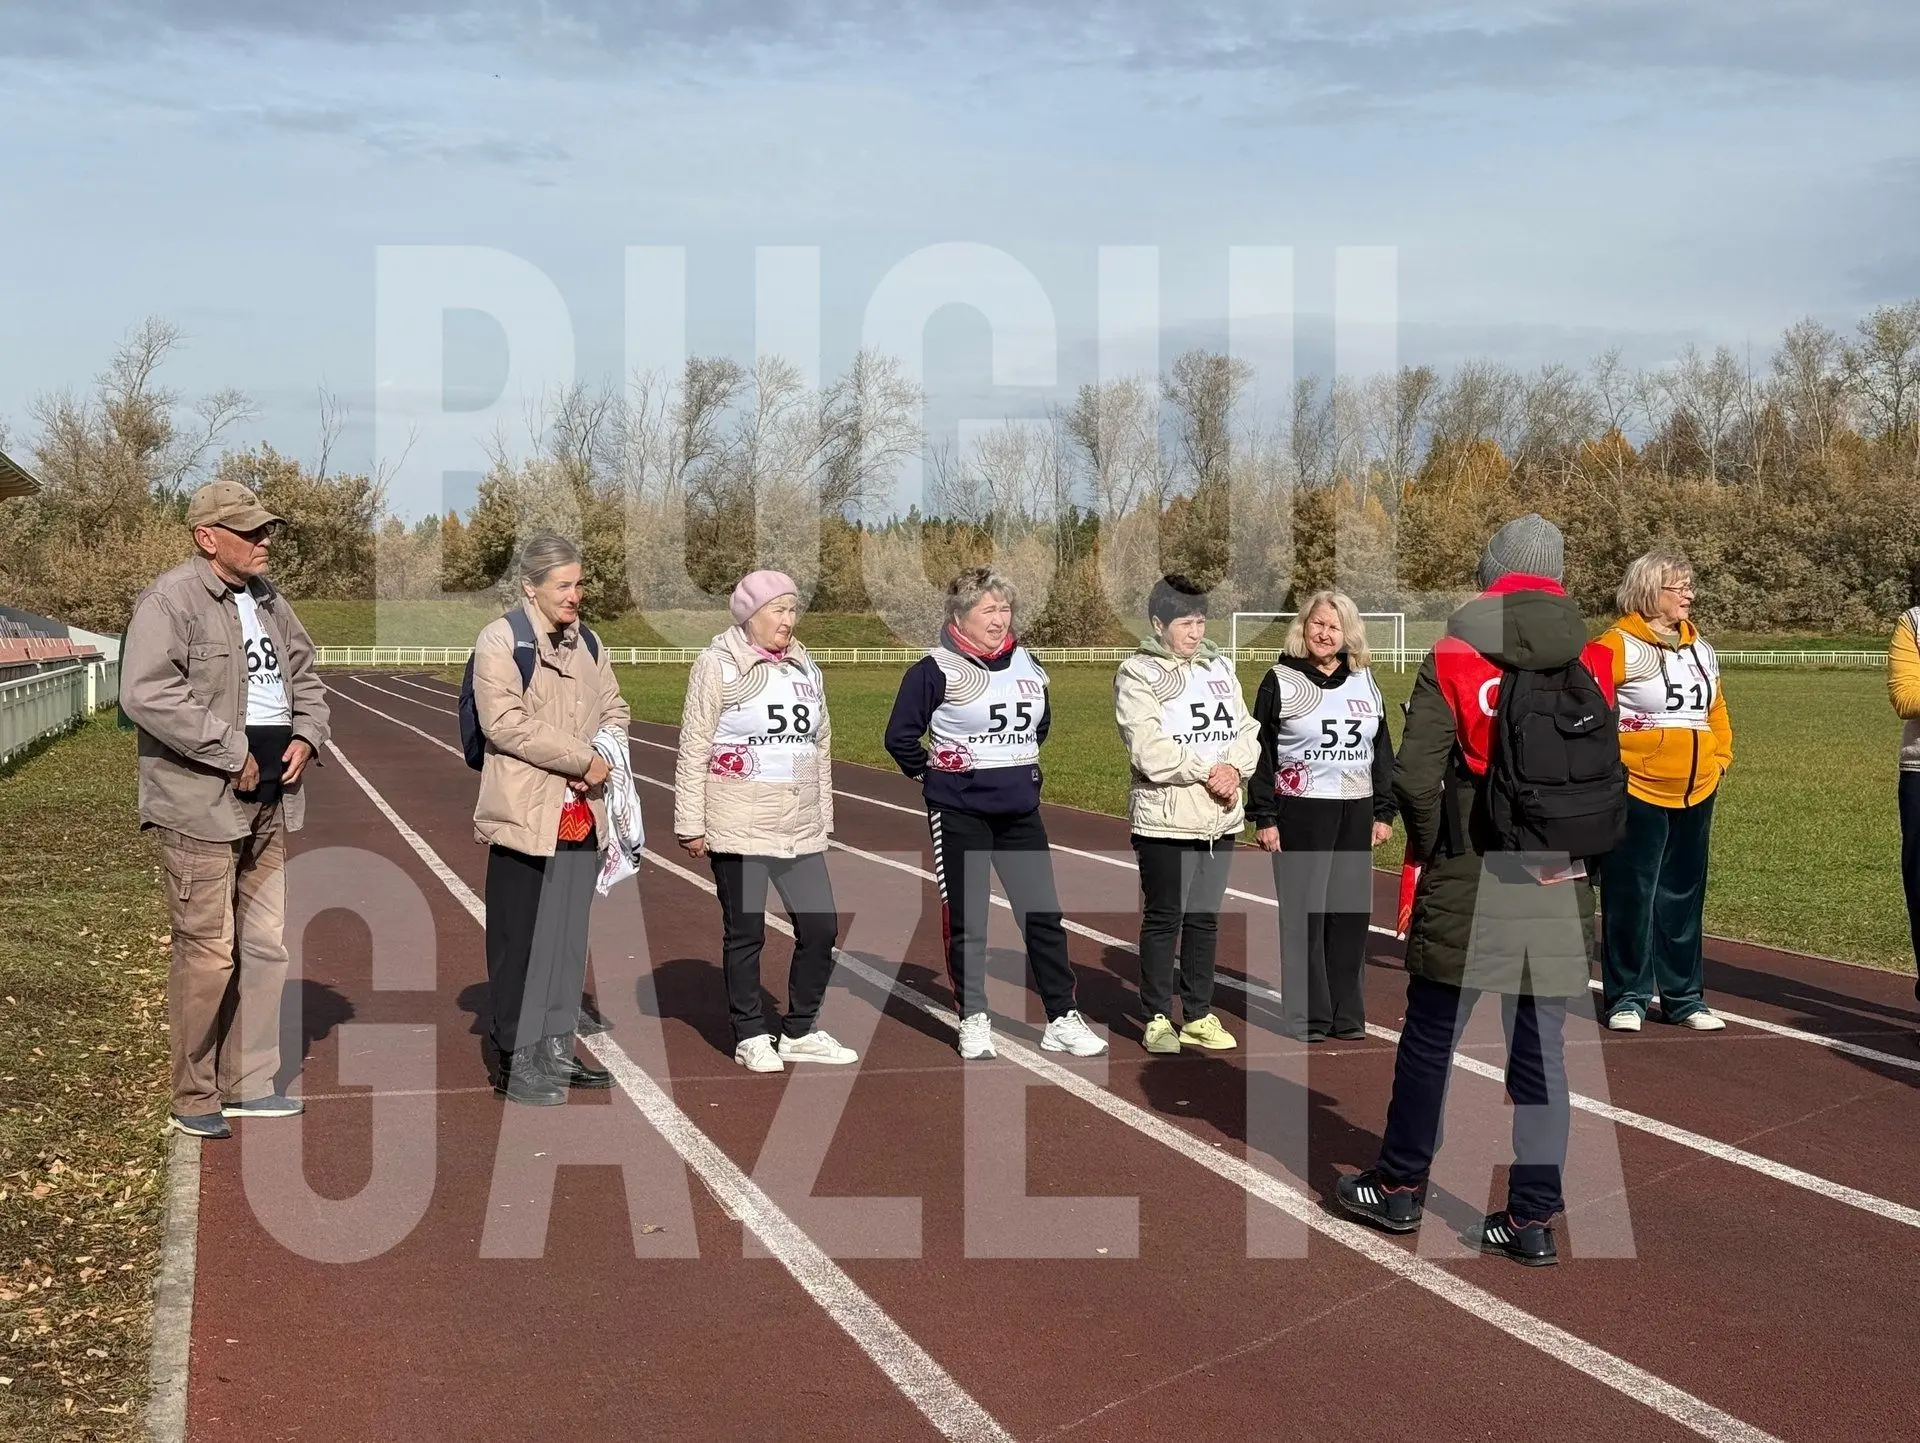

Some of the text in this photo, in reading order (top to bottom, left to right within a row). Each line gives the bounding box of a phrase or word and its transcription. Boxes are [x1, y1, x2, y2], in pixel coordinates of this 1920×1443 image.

[244, 637, 278, 672] 68
[1666, 684, 1704, 711] 51
[767, 704, 811, 734] 58
[988, 702, 1032, 733] 55
[1190, 702, 1234, 731] 54
[748, 735, 816, 746] БУГУЛЬ
[1173, 731, 1238, 745] БУГУЛЬМ
[1320, 719, 1362, 749] 53
[1304, 750, 1368, 760] БУГУЛЬМА
